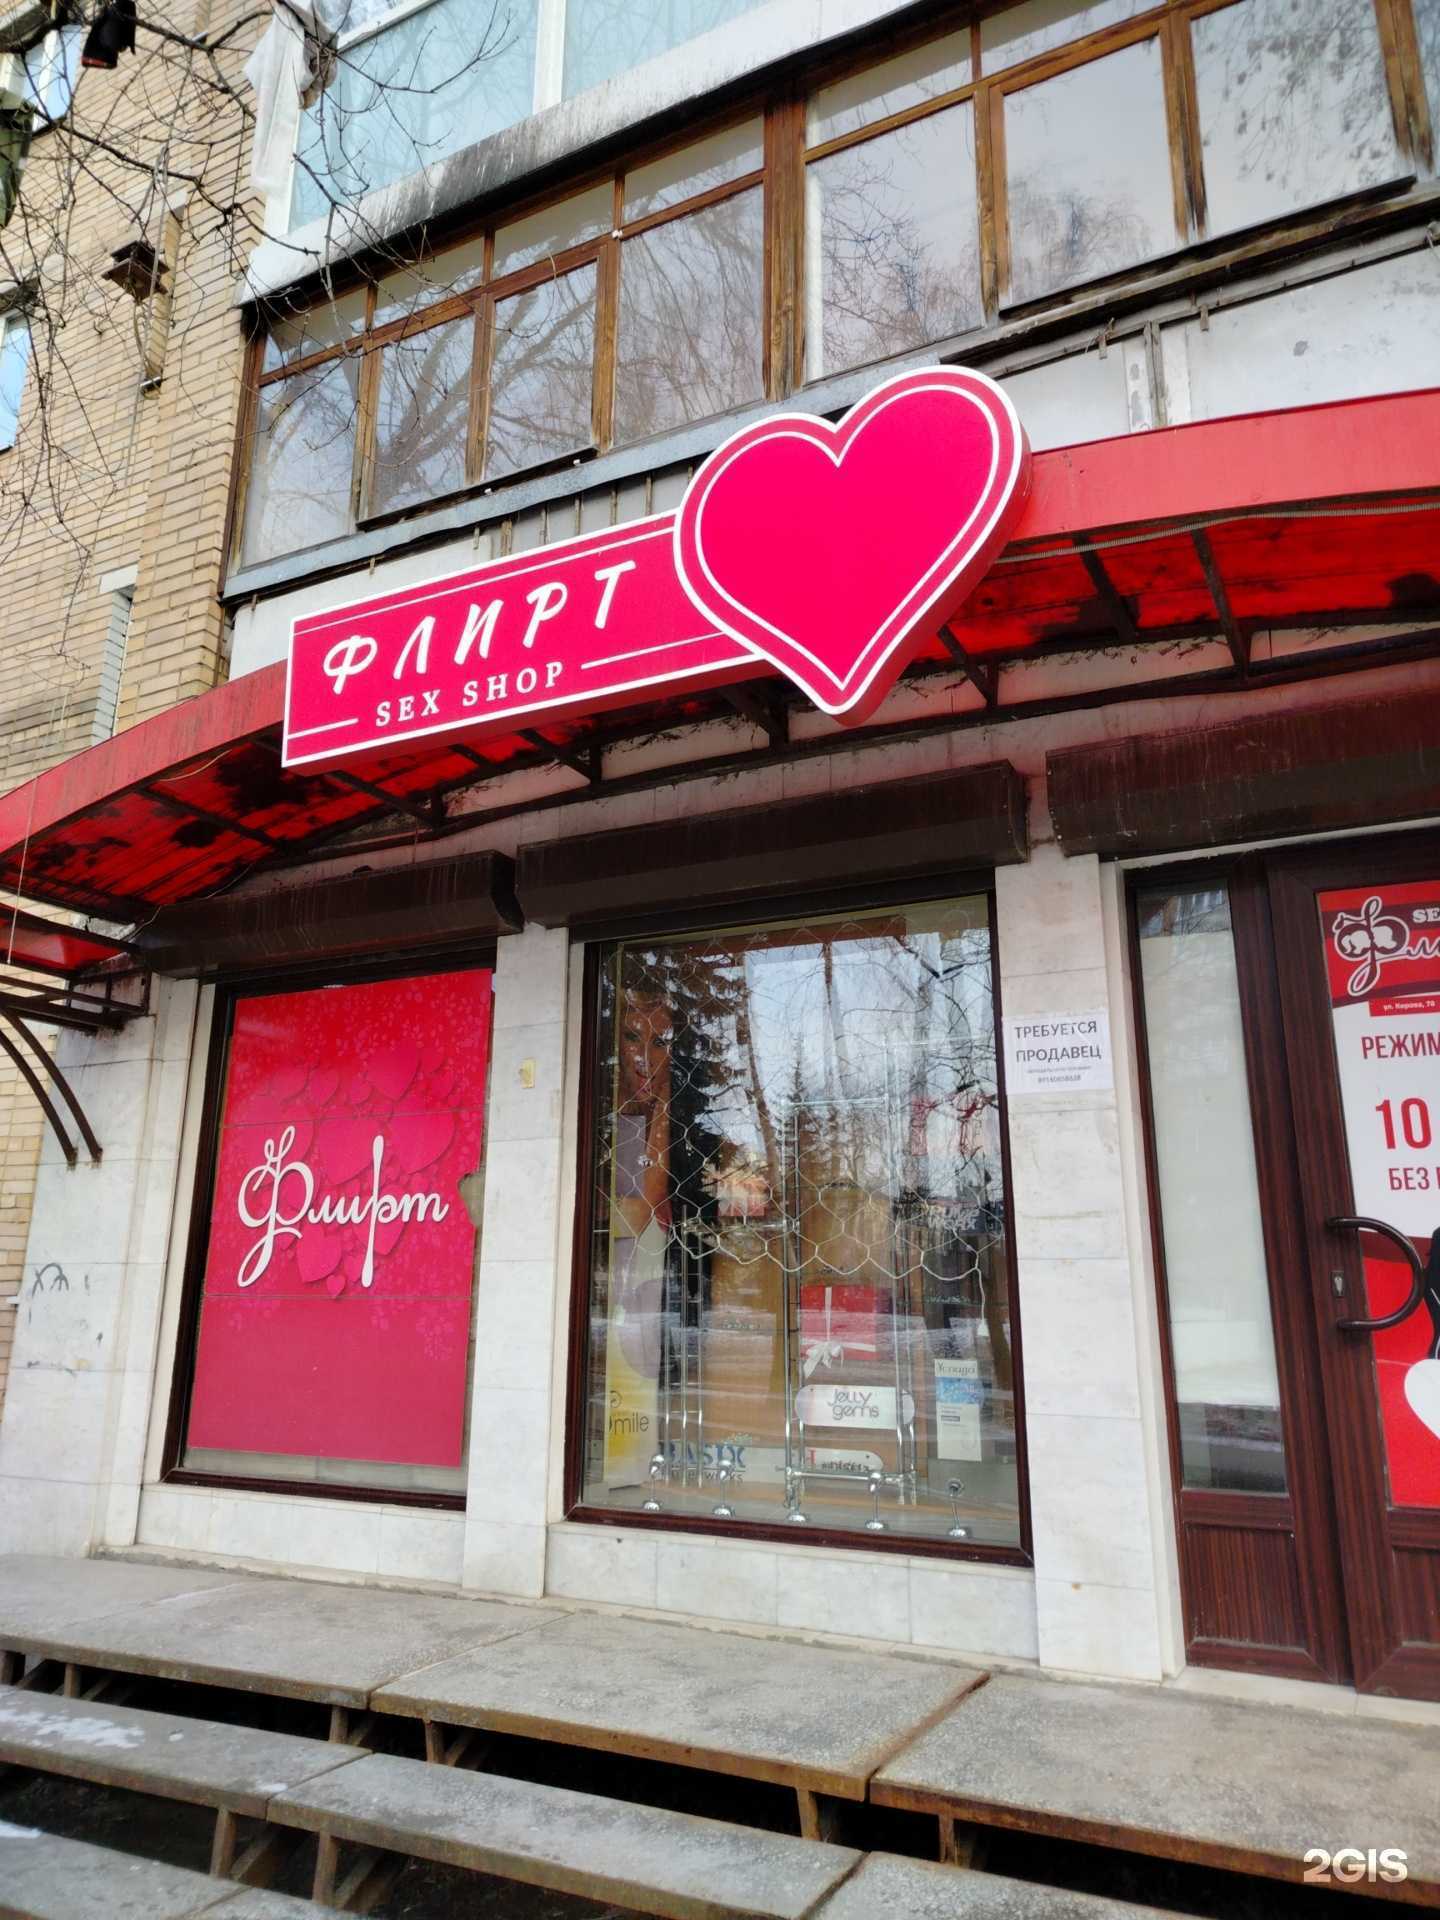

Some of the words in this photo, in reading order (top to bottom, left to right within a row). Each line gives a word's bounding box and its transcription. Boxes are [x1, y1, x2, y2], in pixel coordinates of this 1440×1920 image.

[323, 560, 636, 695] ФЛИРТ
[375, 689, 441, 727] SEX
[462, 661, 564, 707] SHOP
[1014, 1020, 1097, 1039] ТРЕБУЕТСЯ
[1016, 1045, 1102, 1063] ПРОДАВЕЦ
[1375, 1097, 1432, 1149] 10
[1388, 1166, 1430, 1190] БЕЗ
